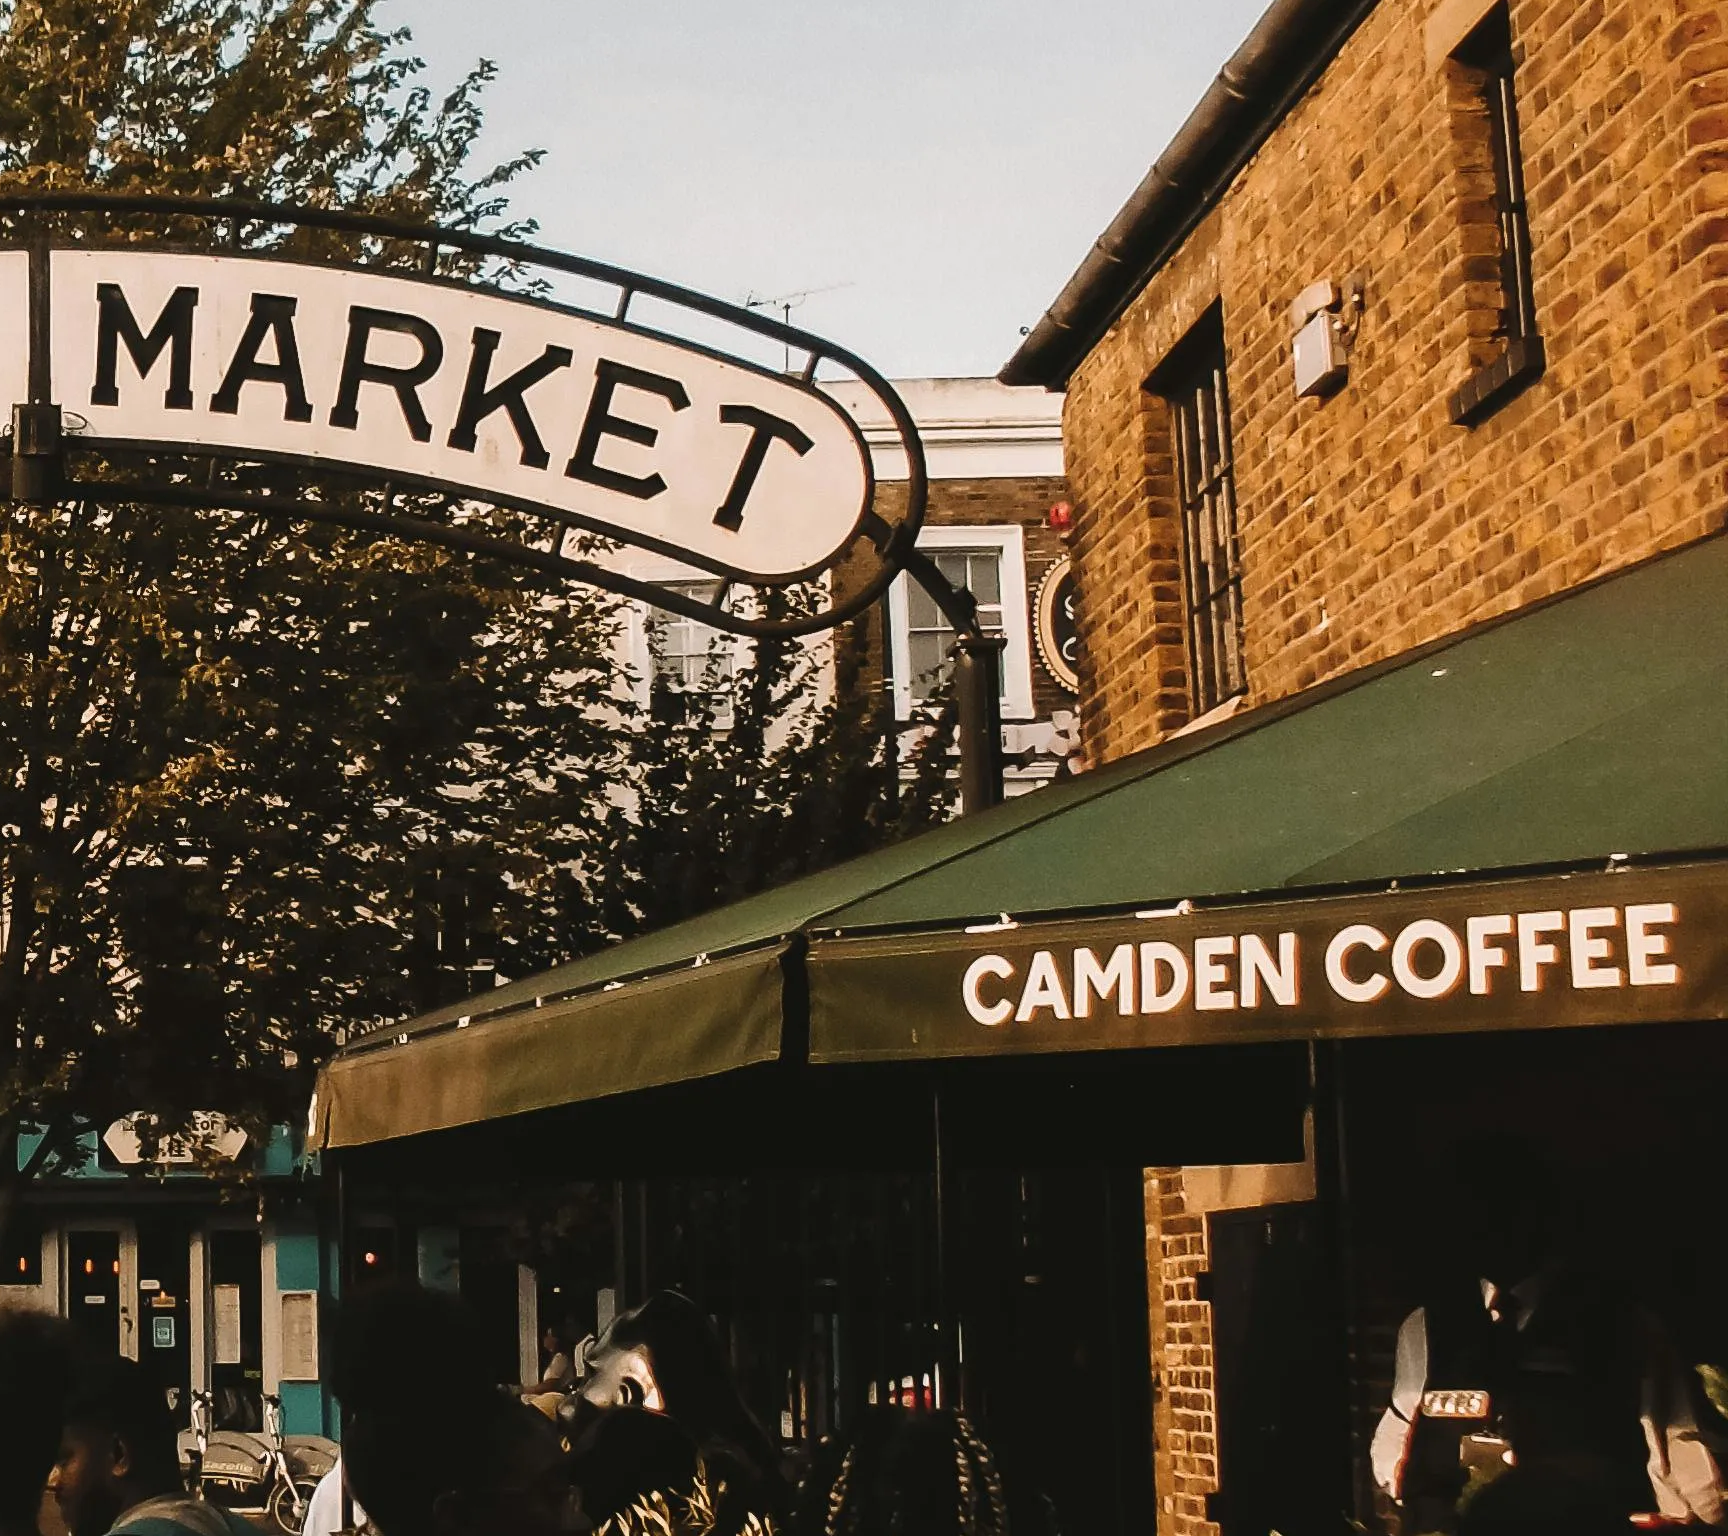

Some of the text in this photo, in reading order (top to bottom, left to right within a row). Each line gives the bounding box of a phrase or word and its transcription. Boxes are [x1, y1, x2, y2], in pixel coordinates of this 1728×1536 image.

[89, 282, 816, 533] MARKET
[962, 903, 1680, 1026] CAMDEN COFFEE
